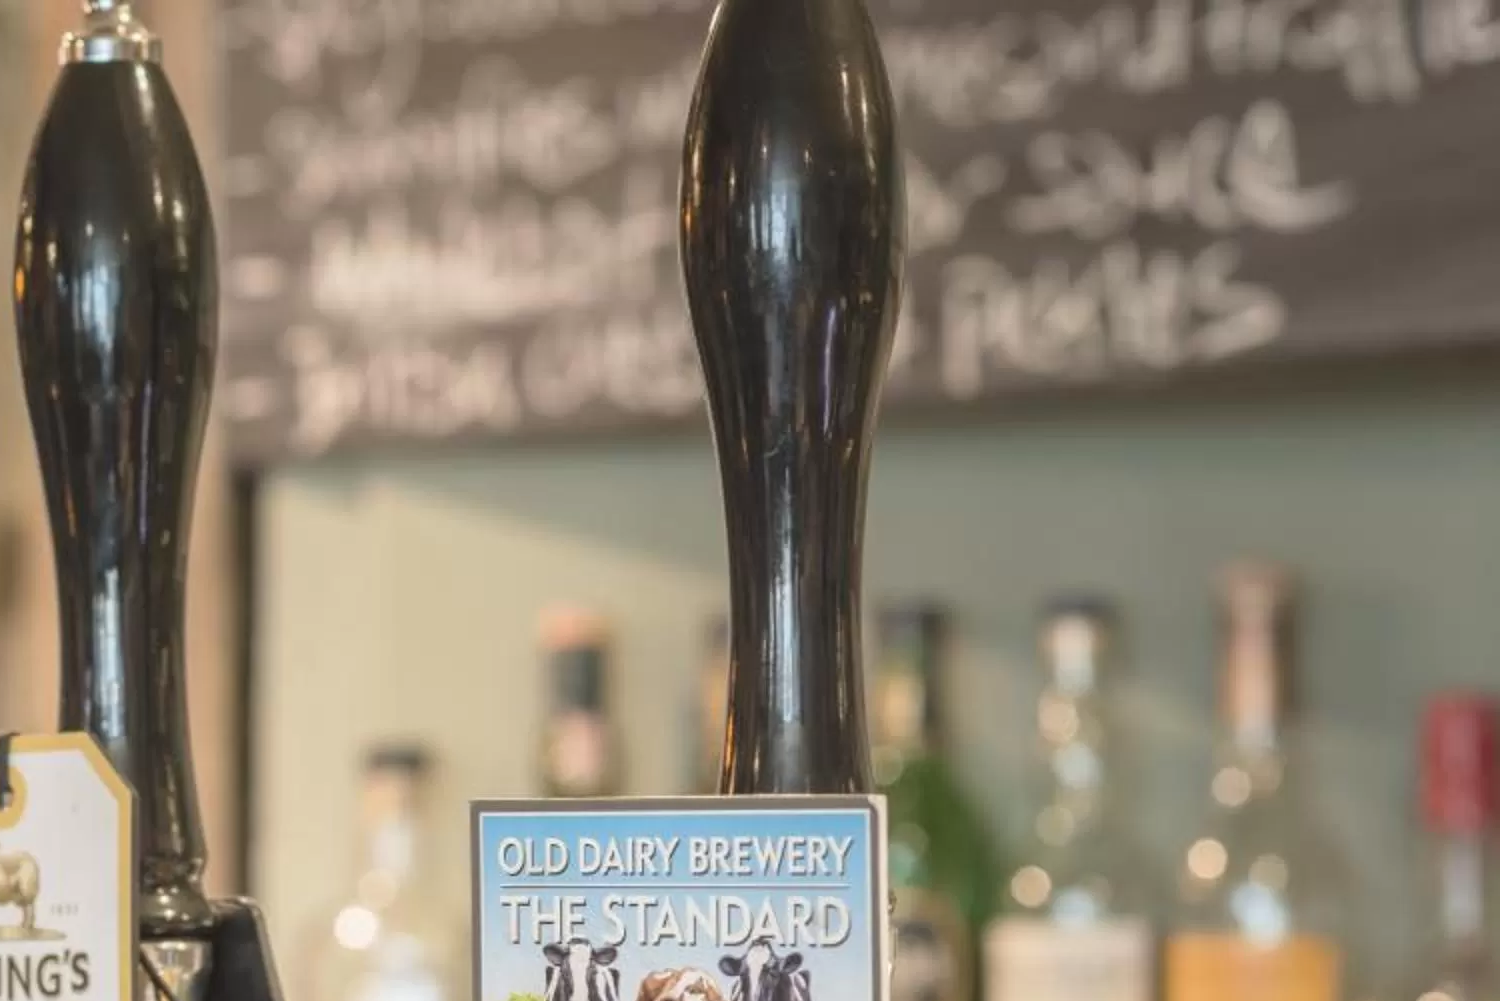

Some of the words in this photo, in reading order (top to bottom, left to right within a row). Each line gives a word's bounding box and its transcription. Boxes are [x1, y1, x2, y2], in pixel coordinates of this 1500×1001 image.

[497, 836, 569, 877] OLD
[578, 836, 680, 877] DAIRY
[689, 835, 854, 879] BREWERY
[501, 894, 587, 946] THE
[602, 895, 853, 948] STANDARD
